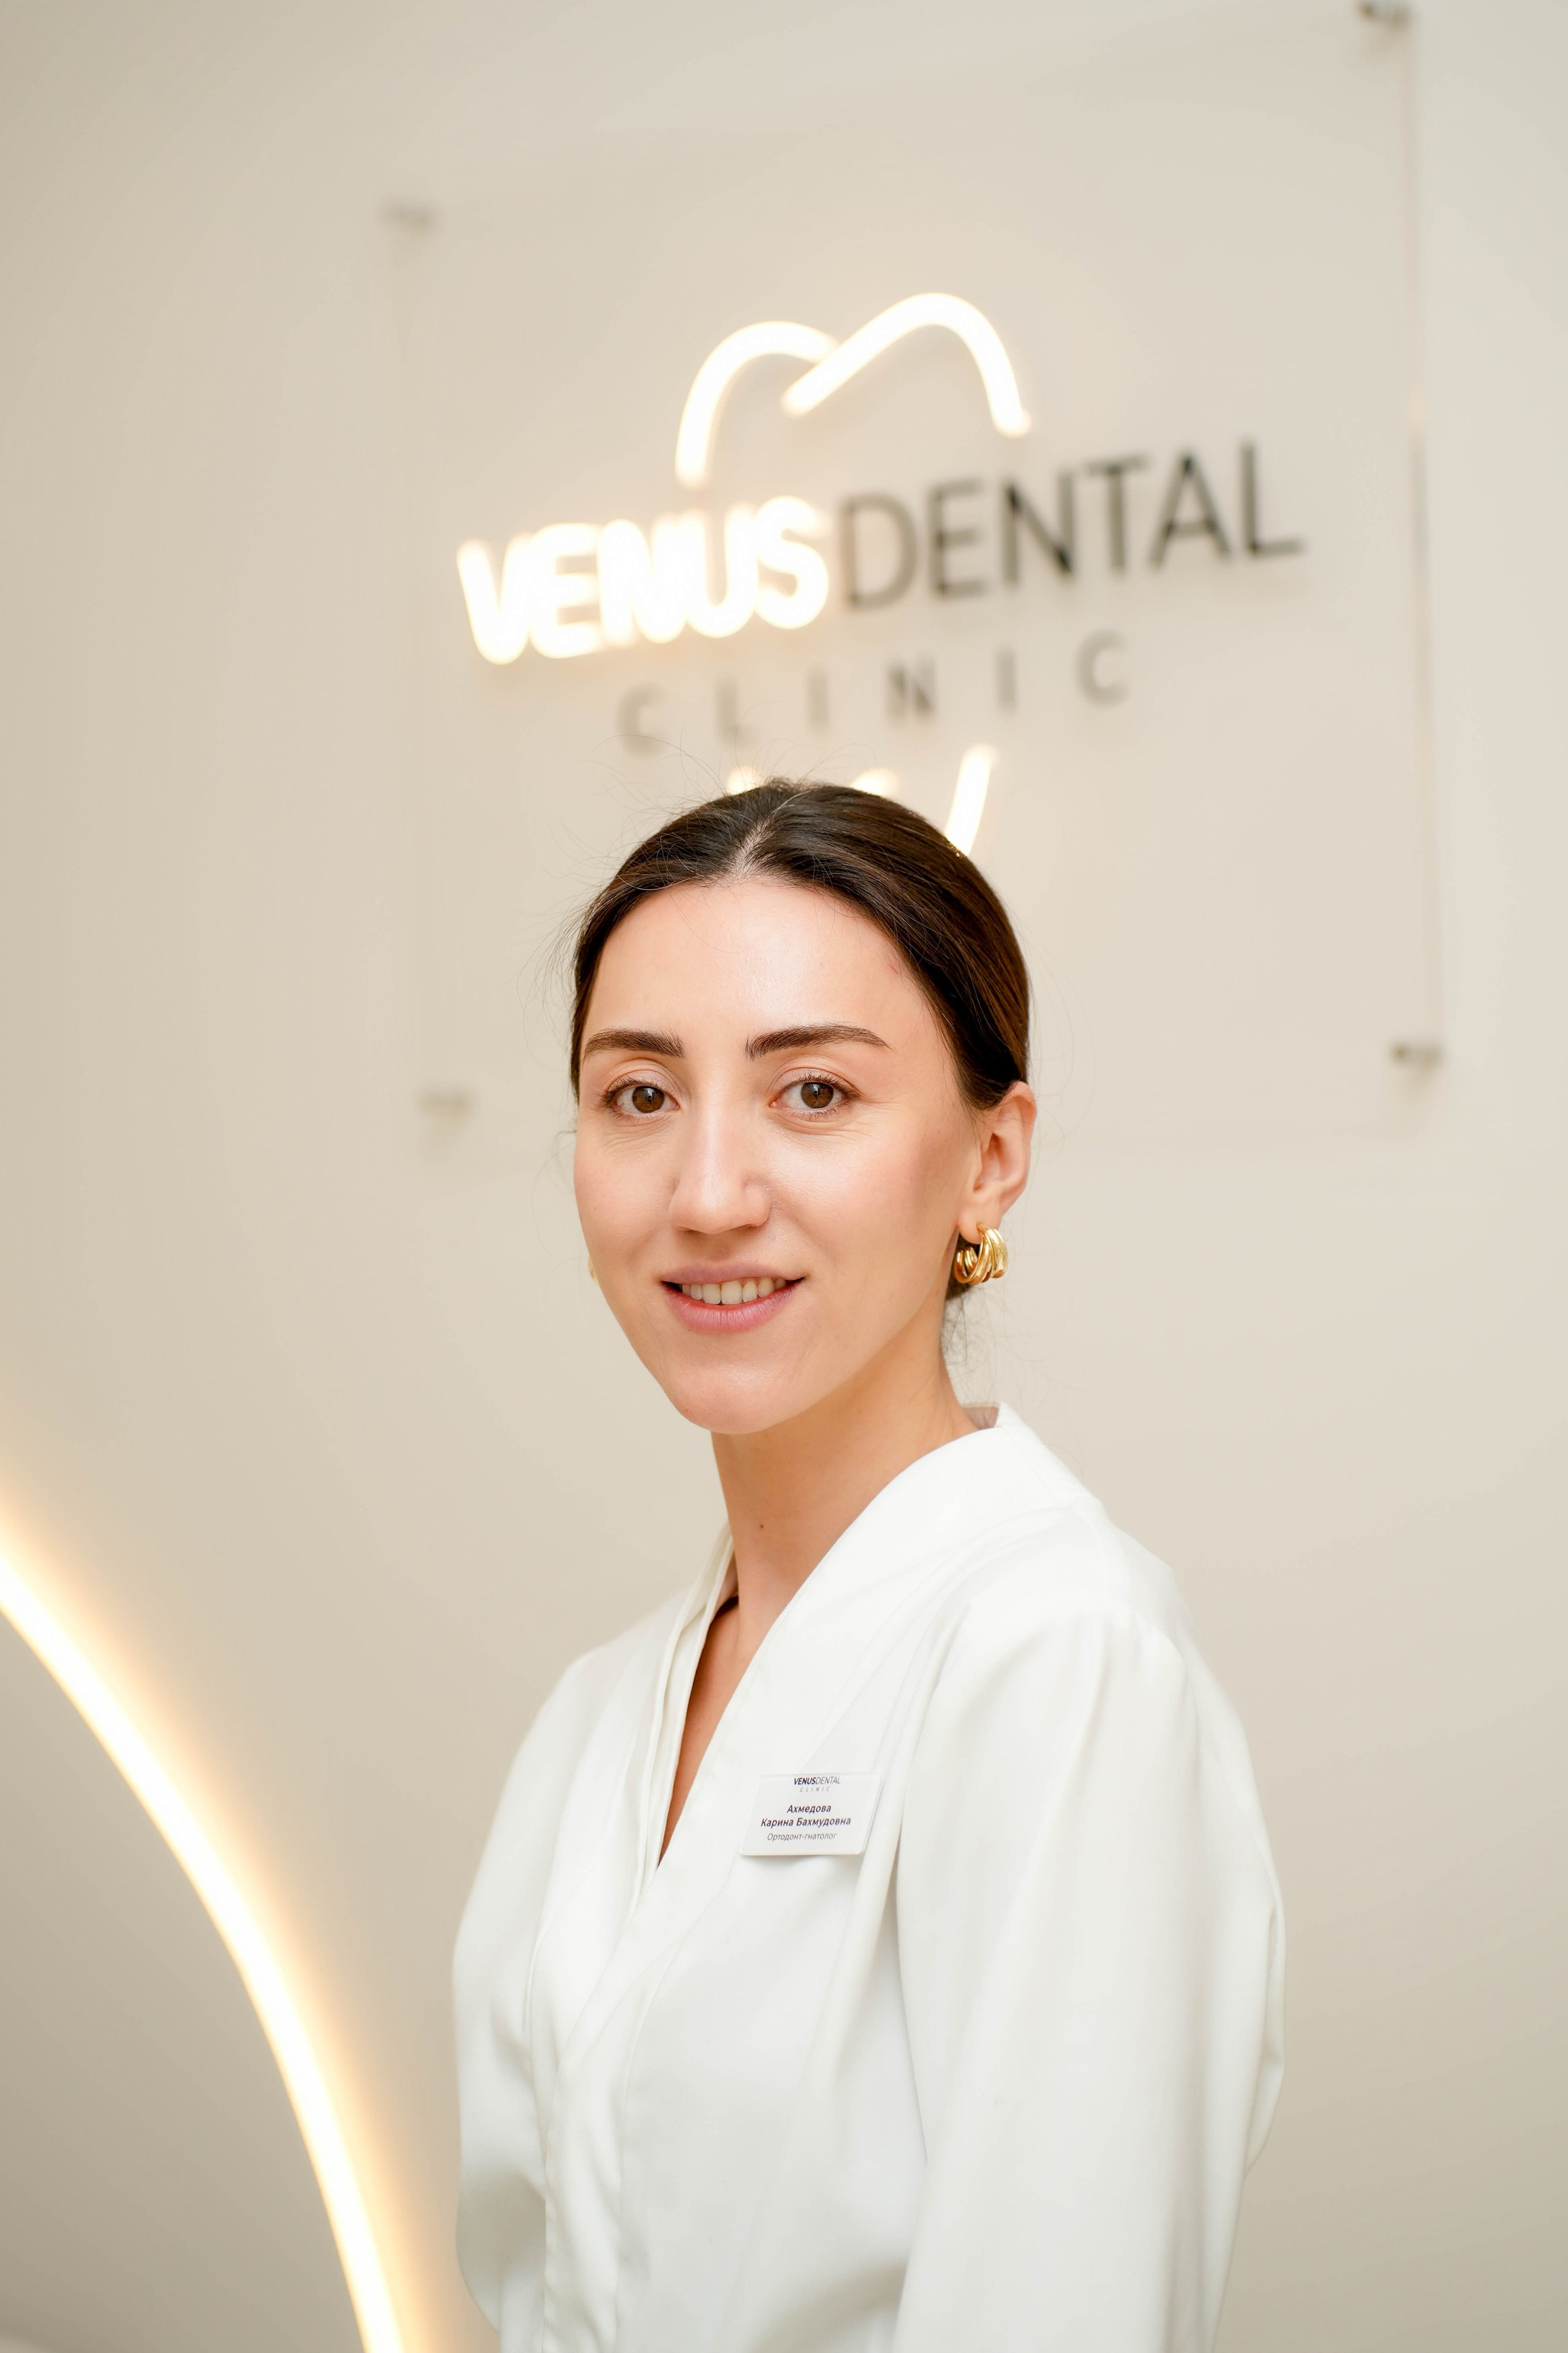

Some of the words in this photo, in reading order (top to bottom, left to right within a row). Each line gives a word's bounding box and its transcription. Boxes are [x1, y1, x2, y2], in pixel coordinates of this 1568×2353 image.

[617, 629, 1128, 758] CLINIC
[786, 1805, 832, 1814] Ахмедова
[761, 1818, 794, 1829] Карина
[796, 1817, 851, 1827] Бахмудовна
[767, 1833, 837, 1842] Ортодонт-гнатолог
